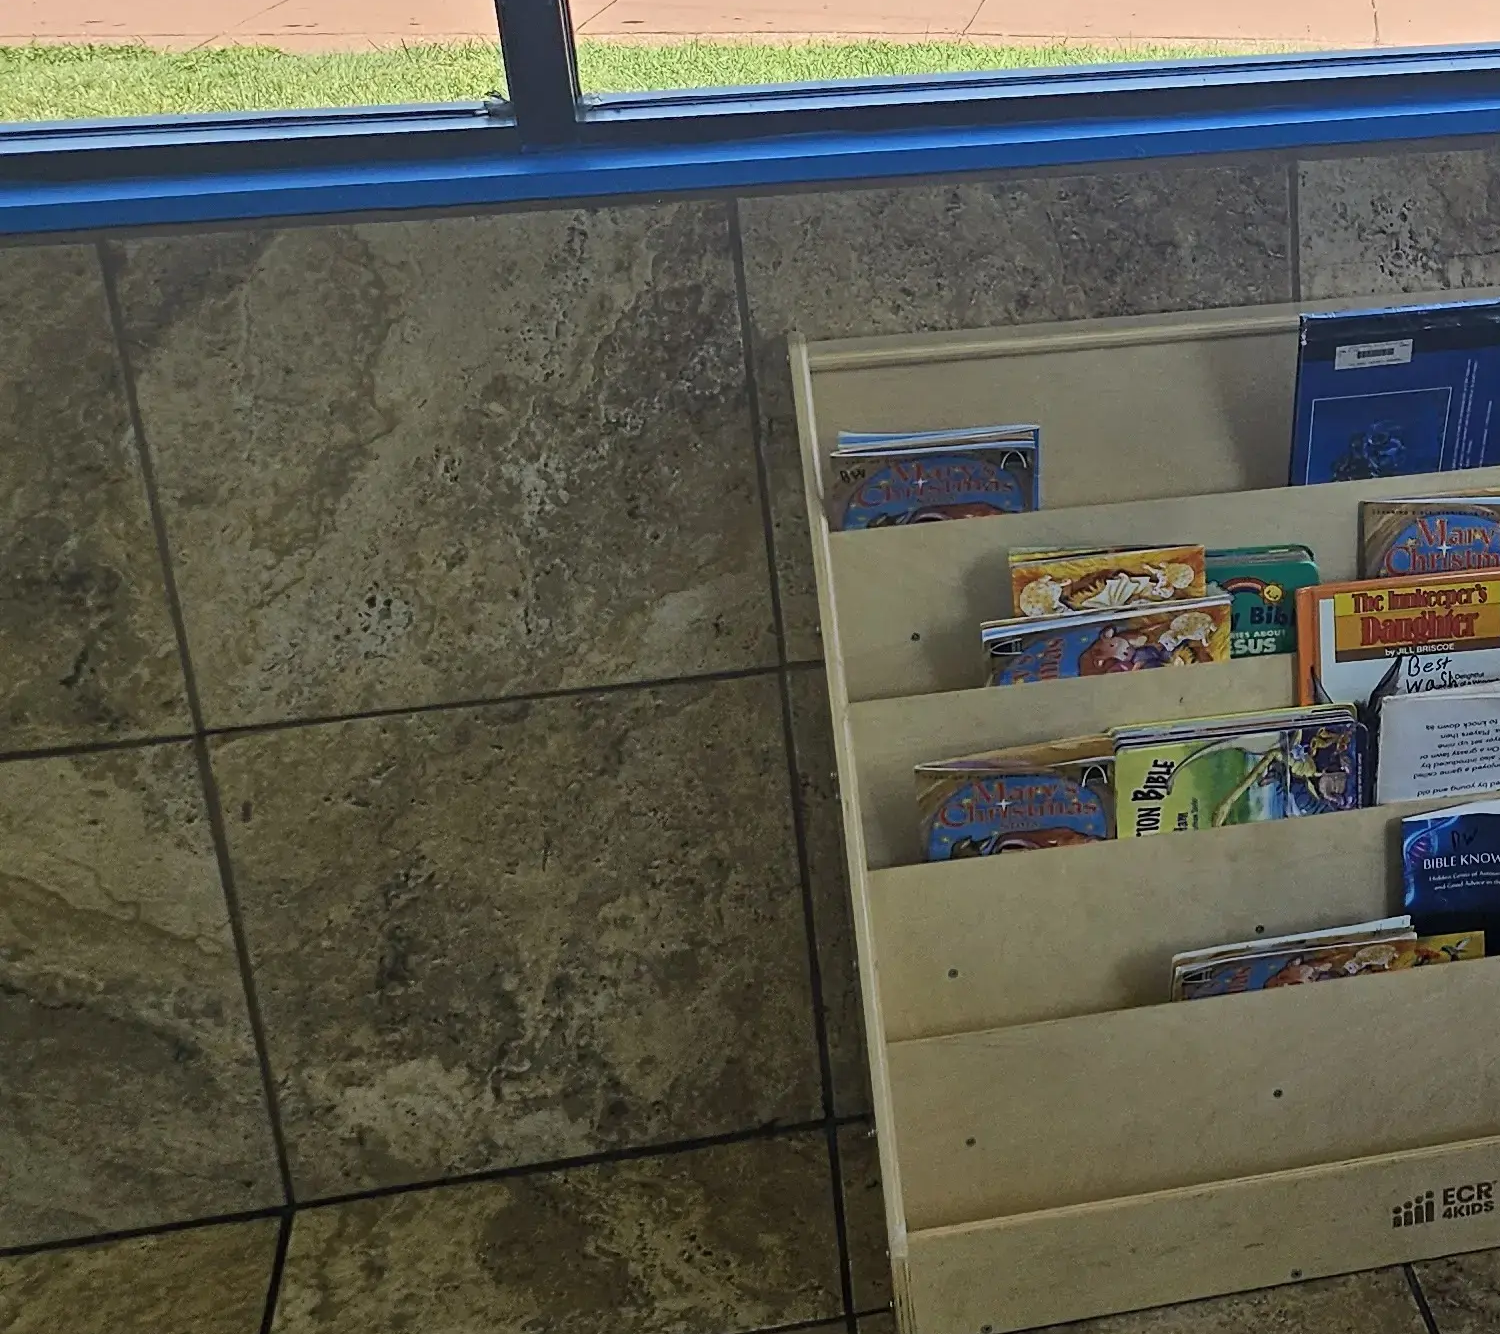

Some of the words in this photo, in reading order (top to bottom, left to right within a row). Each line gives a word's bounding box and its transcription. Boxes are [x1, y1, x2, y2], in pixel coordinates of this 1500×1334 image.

[889, 462, 996, 483] Mary's
[856, 478, 1013, 507] Christmas
[1352, 593, 1384, 614] The
[1388, 583, 1488, 611] Innkeeper's
[1253, 629, 1286, 638] ABOUT
[1360, 610, 1480, 646] Daughter
[1230, 637, 1277, 654] SUS
[1385, 648, 1395, 657] by
[1396, 645, 1414, 656] JILL
[1416, 643, 1455, 654] BRISCOE
[1408, 656, 1452, 677] Best
[1437, 723, 1460, 731] down
[1463, 720, 1487, 730] knock
[1488, 718, 1498, 726] to
[1461, 728, 1491, 738] Players
[1457, 739, 1469, 747] up
[1430, 752, 1450, 760] lawn
[1452, 747, 1478, 756] grassy
[1420, 760, 1431, 769] by
[1433, 757, 1477, 768] introduced
[1439, 767, 1463, 776] game
[1130, 758, 1175, 802] BIBLE
[1477, 781, 1488, 789] by
[971, 780, 1077, 804] Mary's
[1432, 787, 1449, 795] and
[1449, 781, 1476, 792] young
[939, 799, 1098, 827] Christmas
[1423, 855, 1457, 870] BIBLE
[1443, 1182, 1493, 1207] ECR
[1442, 1200, 1495, 1219] 4KIDS
